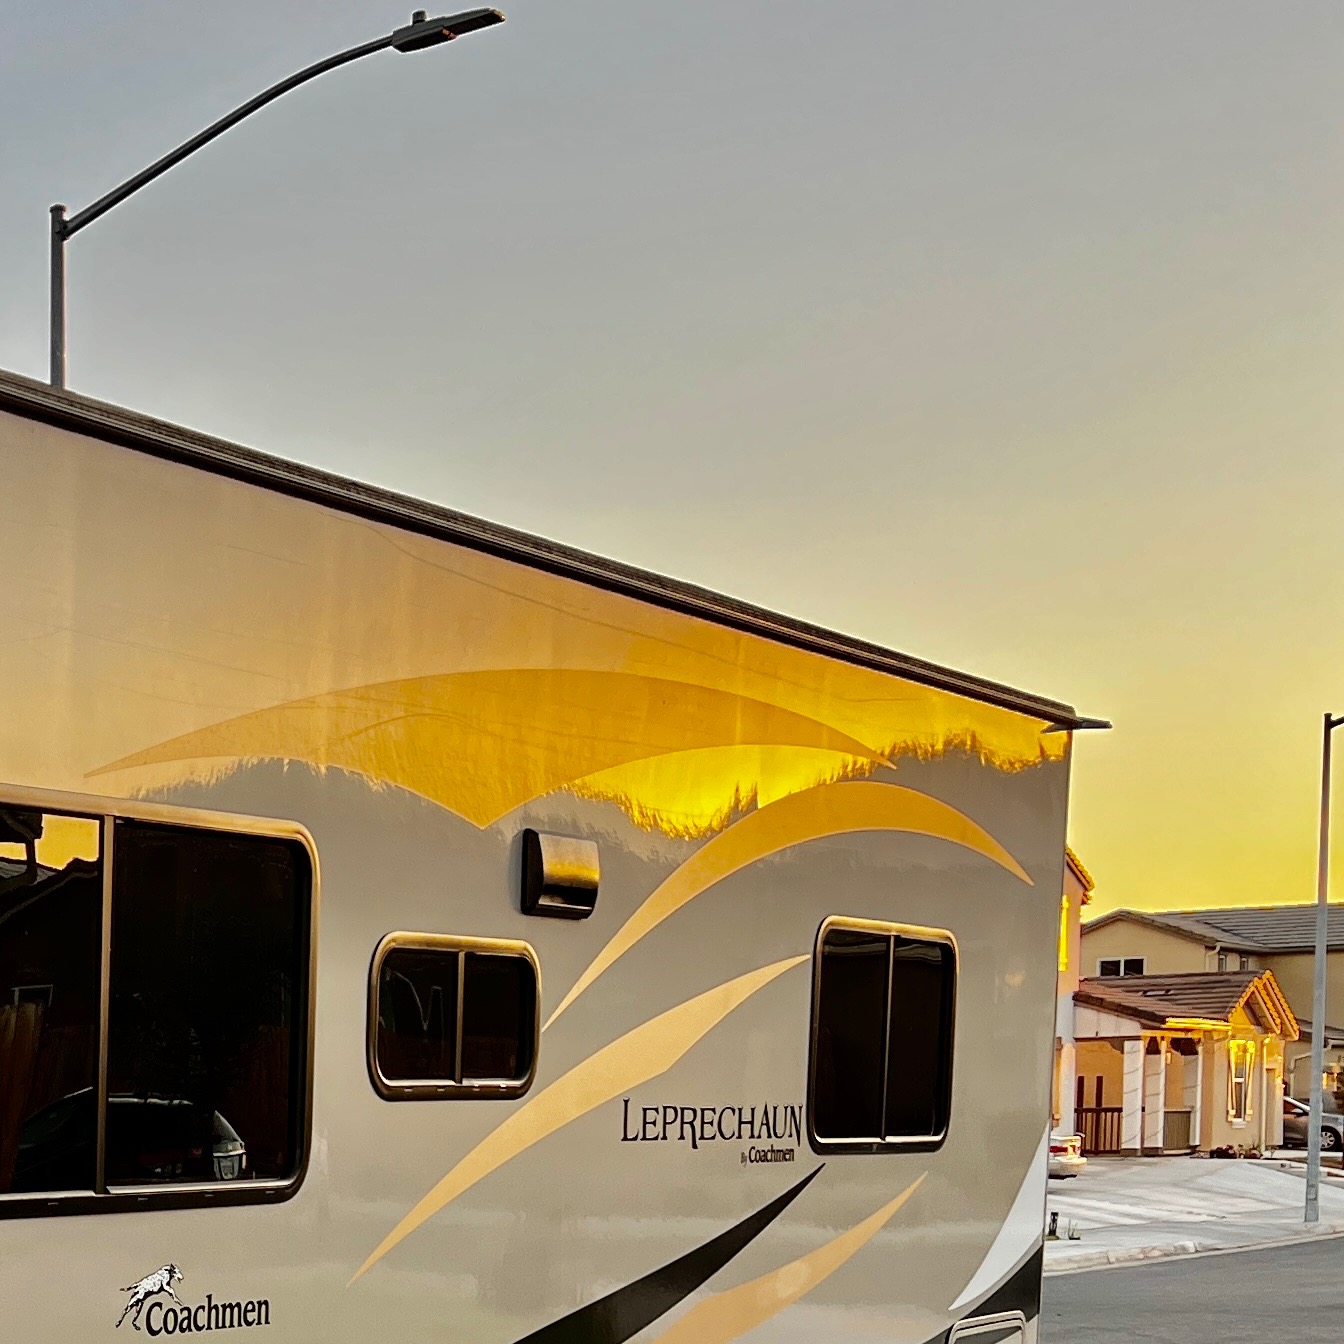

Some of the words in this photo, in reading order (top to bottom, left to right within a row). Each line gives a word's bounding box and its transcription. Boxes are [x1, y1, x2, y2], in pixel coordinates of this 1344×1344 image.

[621, 1097, 803, 1149] LEPRECHAUN
[749, 1144, 795, 1163] Coachmen
[145, 1294, 270, 1336] Coachmen
